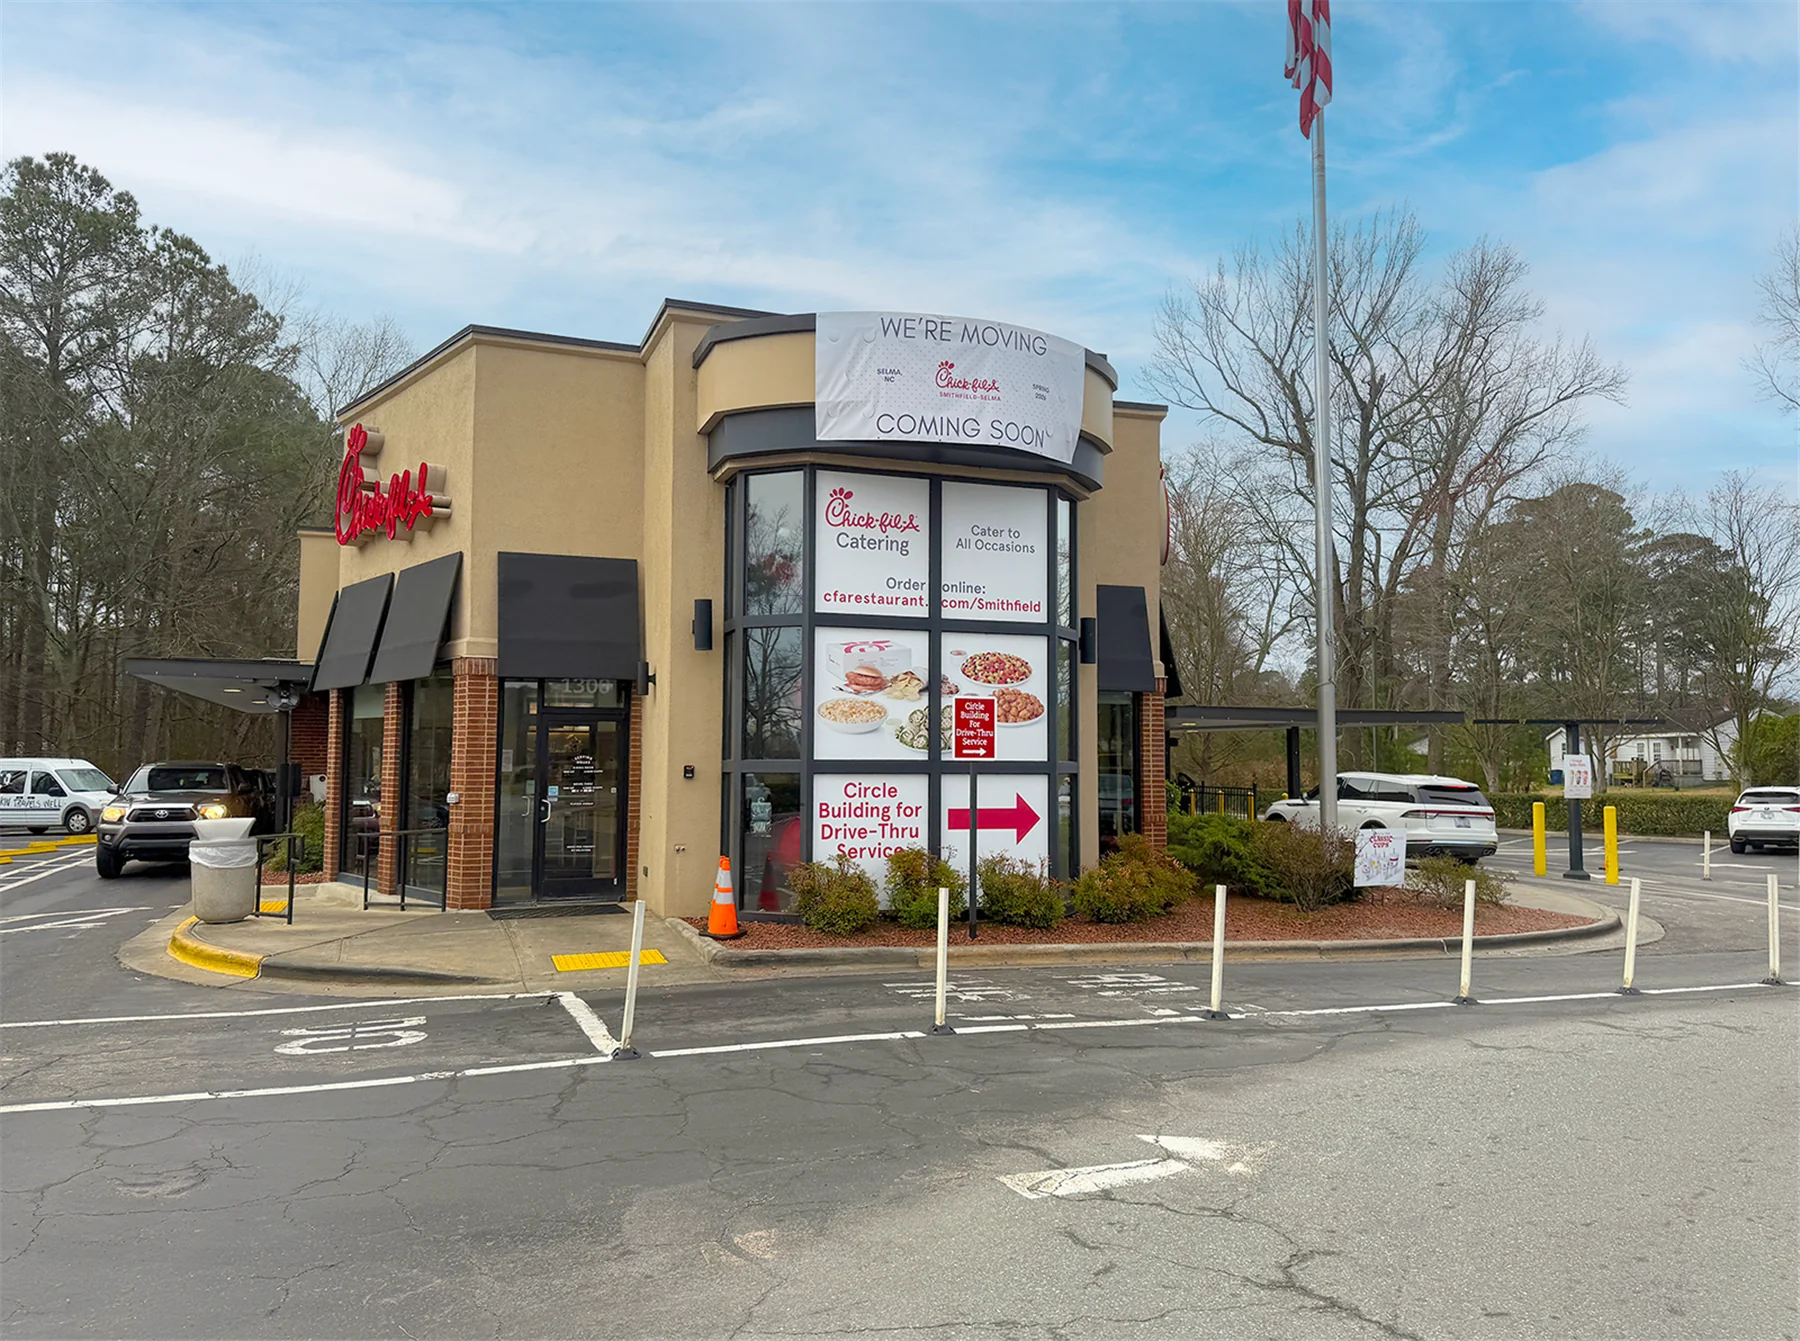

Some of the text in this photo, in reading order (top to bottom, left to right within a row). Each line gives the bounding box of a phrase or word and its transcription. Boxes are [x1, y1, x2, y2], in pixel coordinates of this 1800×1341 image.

[960, 323, 1048, 357] MOVING
[875, 413, 1045, 448] COMING SOON
[971, 525, 1021, 539] Cater to
[836, 532, 910, 556] Catering
[956, 538, 1035, 554] All Occasions
[886, 577, 986, 595] Order online:
[964, 702, 985, 710] Circle
[960, 711, 990, 721] Building
[969, 720, 981, 728] For
[956, 728, 994, 737] Drive-Thru
[962, 737, 988, 746] Service
[843, 782, 898, 798] Circle
[819, 801, 922, 822] Building for
[821, 823, 919, 840] Drive-Thru
